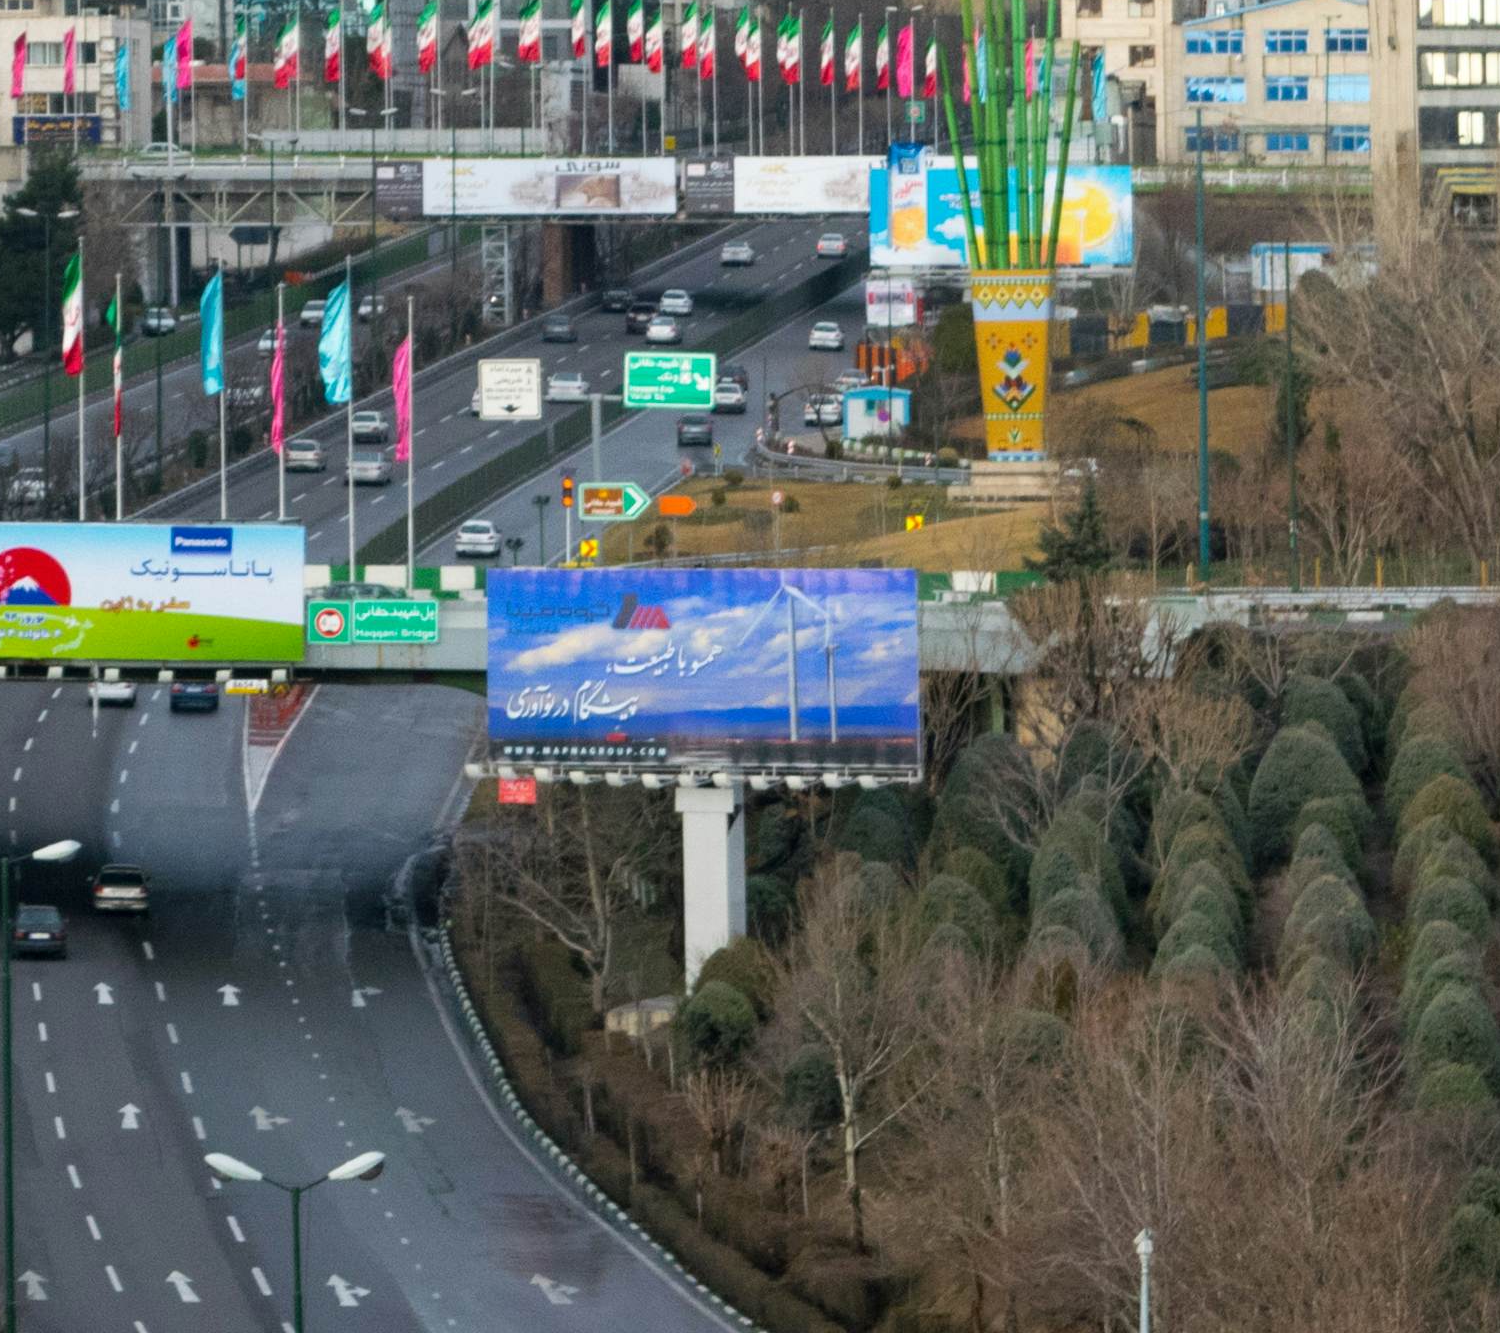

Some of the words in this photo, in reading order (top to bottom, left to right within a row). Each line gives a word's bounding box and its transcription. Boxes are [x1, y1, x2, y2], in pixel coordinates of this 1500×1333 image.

[174, 536, 228, 548] Panasonic
[130, 559, 274, 583] پاناسونیک
[677, 645, 687, 676] با
[688, 644, 723, 676] همسو
[574, 679, 640, 724] پیشگام
[503, 745, 667, 756] WWW.MAPNAGROUP.COM
